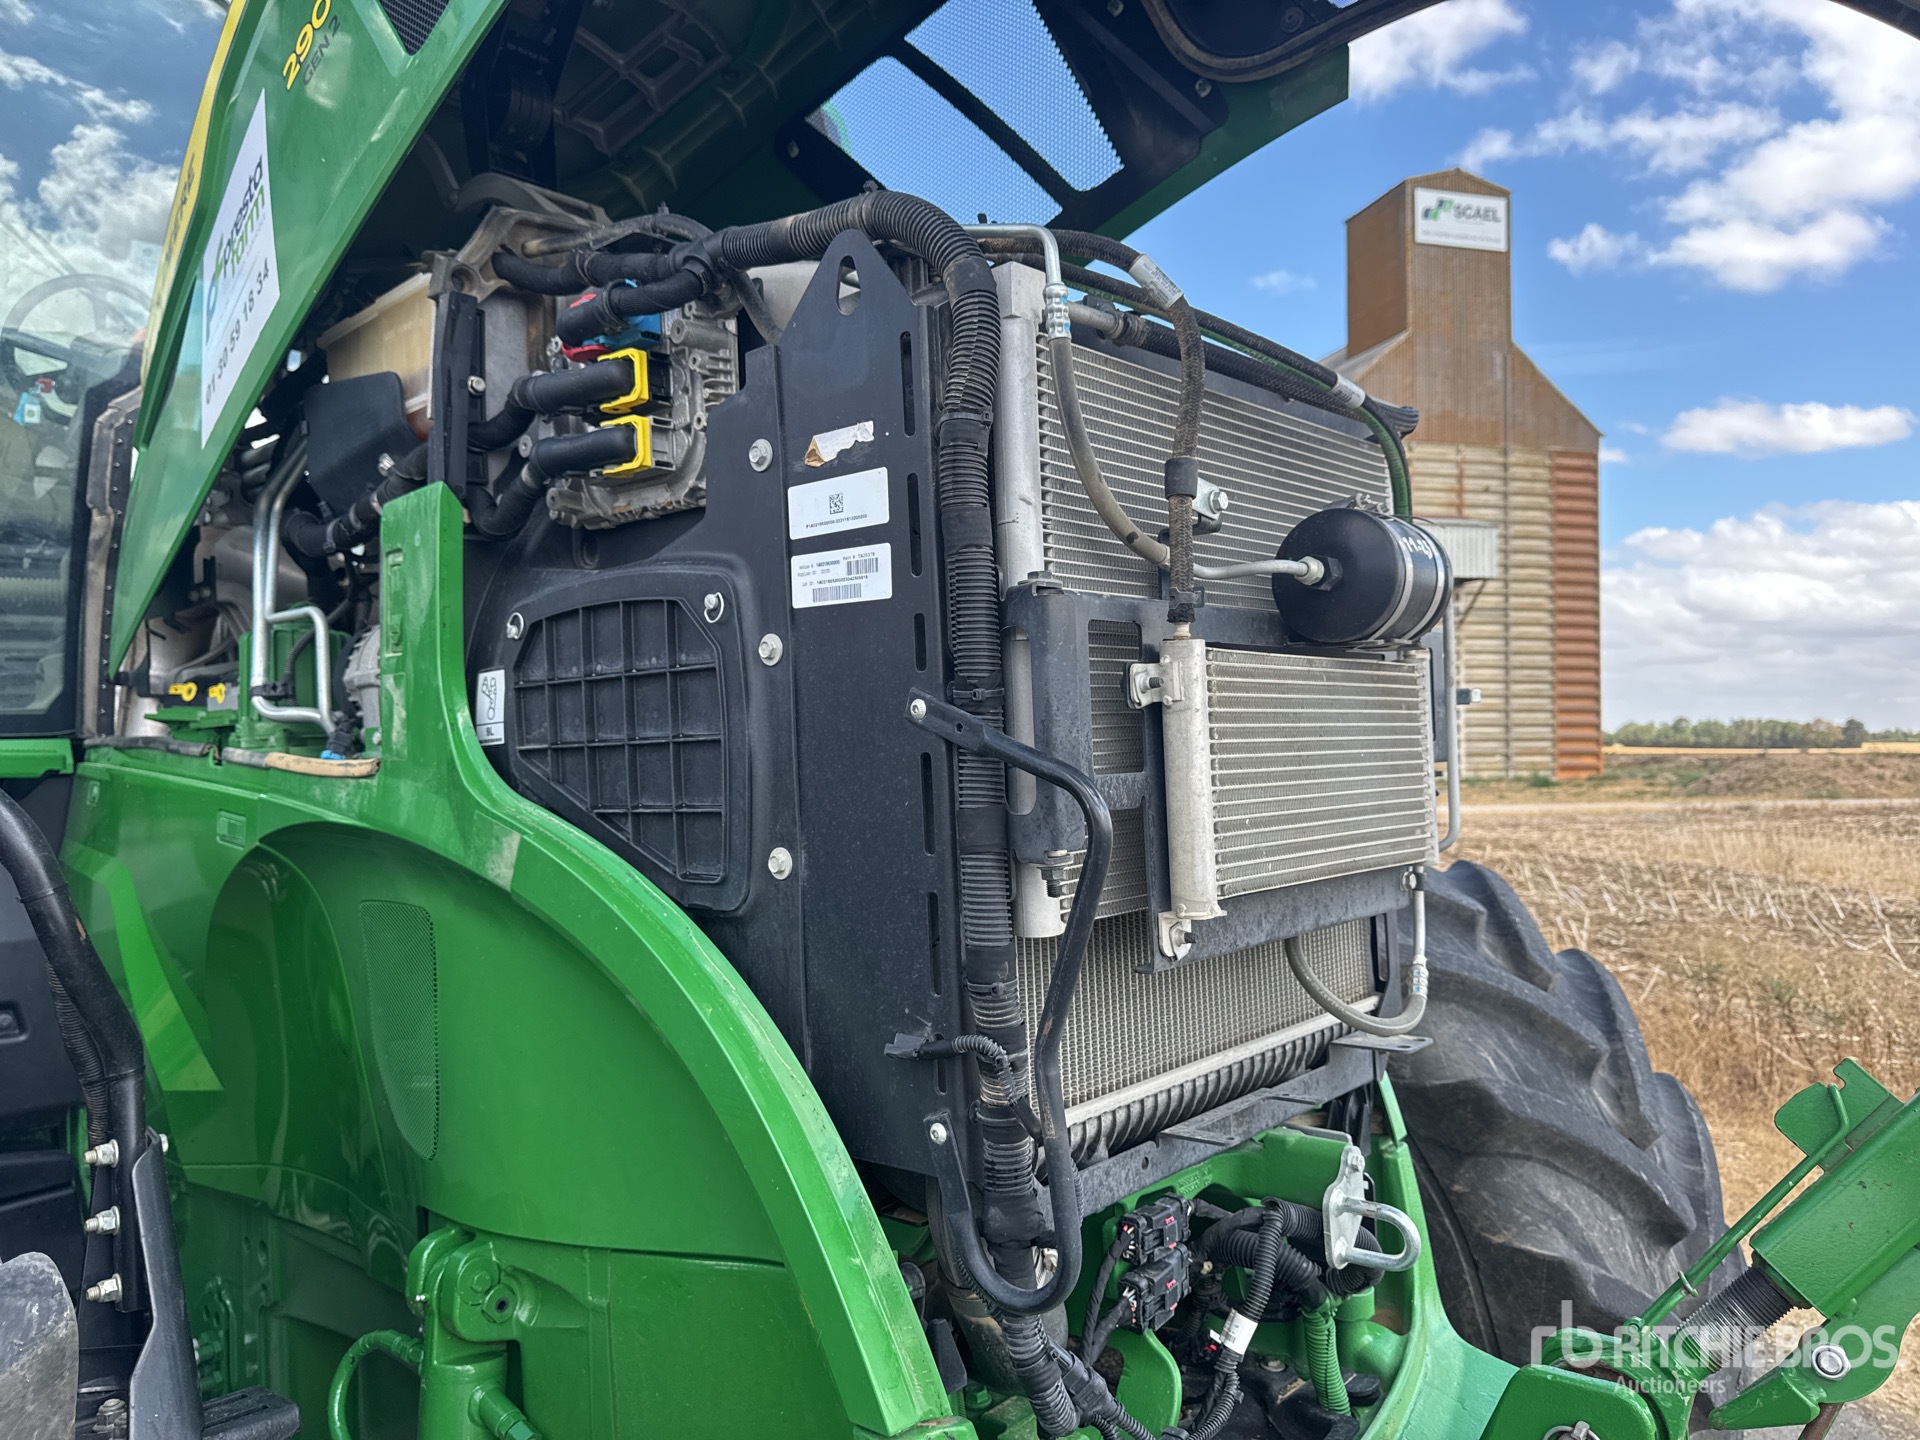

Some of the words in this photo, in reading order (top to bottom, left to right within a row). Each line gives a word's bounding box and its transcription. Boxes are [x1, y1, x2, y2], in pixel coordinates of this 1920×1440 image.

[282, 0, 332, 92] 290
[303, 34, 330, 86] GEN
[328, 14, 341, 38] 2
[223, 154, 263, 280] presta
[231, 184, 266, 279] farm
[1453, 203, 1502, 223] SCAEL
[205, 373, 216, 405] 01
[217, 346, 229, 380] 30
[229, 318, 241, 353] 59
[242, 288, 255, 323] 18
[256, 256, 270, 296] 34
